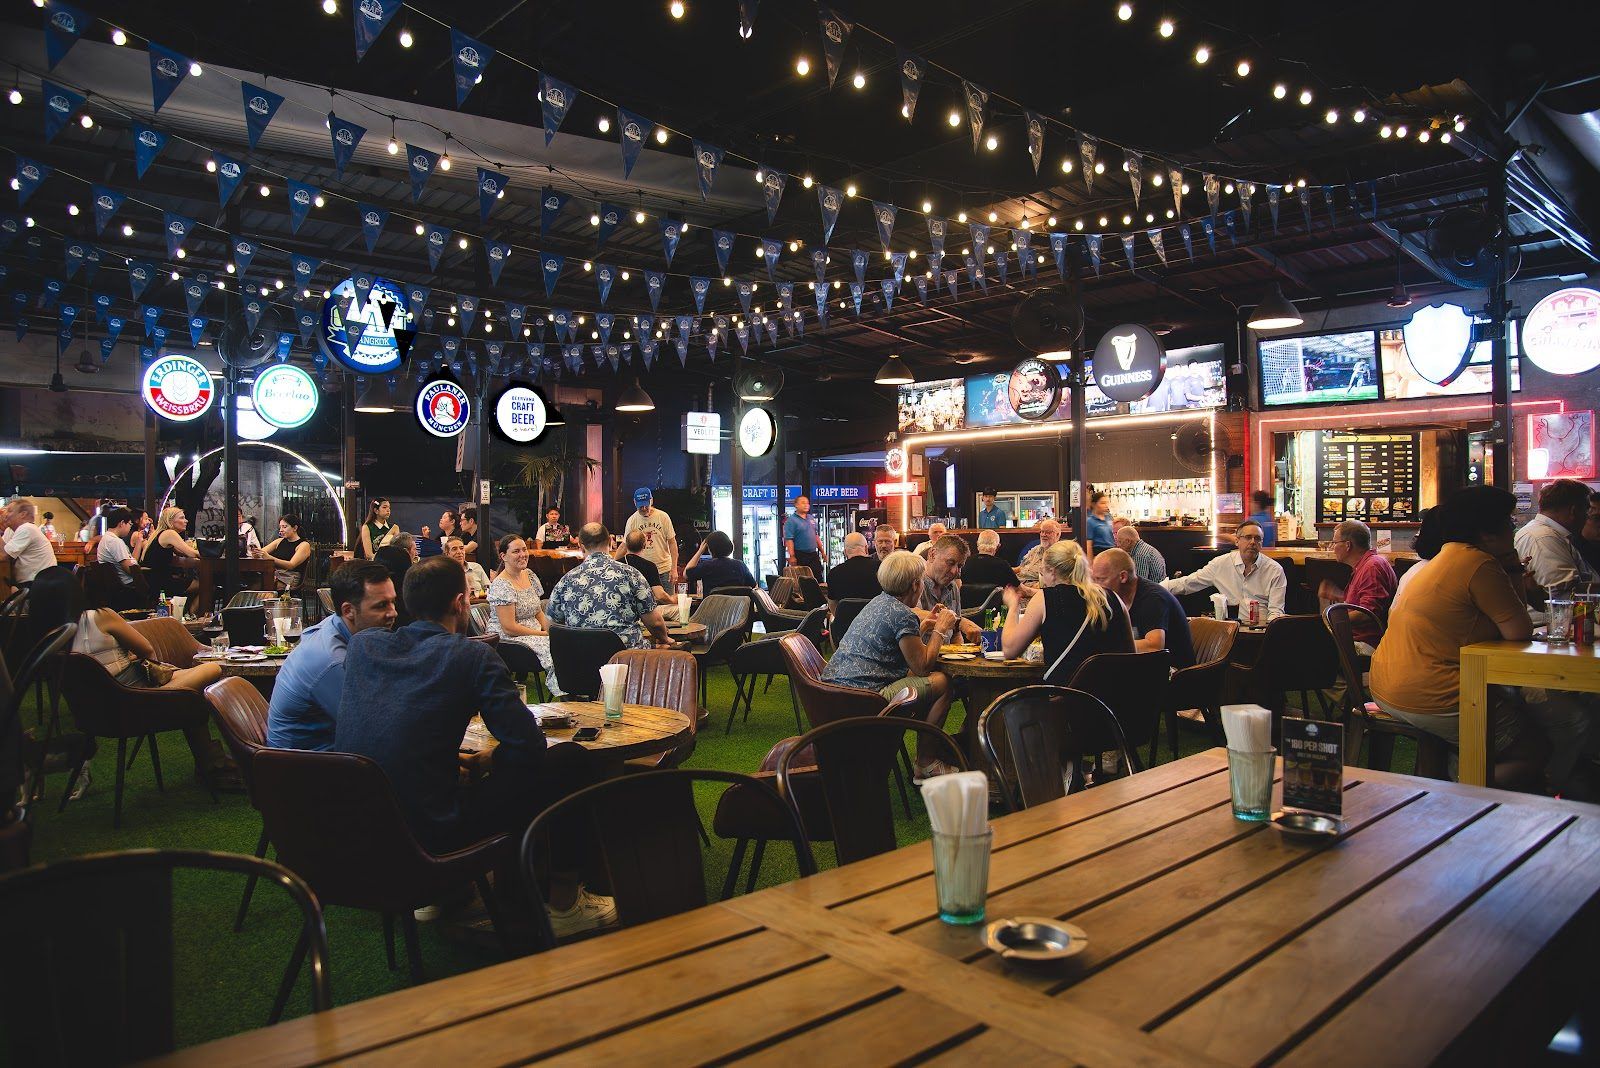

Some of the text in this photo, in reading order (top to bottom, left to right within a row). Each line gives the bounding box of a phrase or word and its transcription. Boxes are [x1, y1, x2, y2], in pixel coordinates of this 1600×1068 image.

[359, 337, 390, 346] ANGKOK
[152, 361, 208, 385] ERDINGER
[1101, 370, 1153, 387] GUINNESS
[425, 384, 466, 404] PAULANER
[511, 401, 535, 412] CRAFT
[511, 413, 535, 425] BEER
[742, 488, 768, 498] CRAFT
[815, 488, 859, 497] CRAFT BEER
[1304, 741, 1317, 751] PER
[1318, 743, 1338, 754] SHOT
